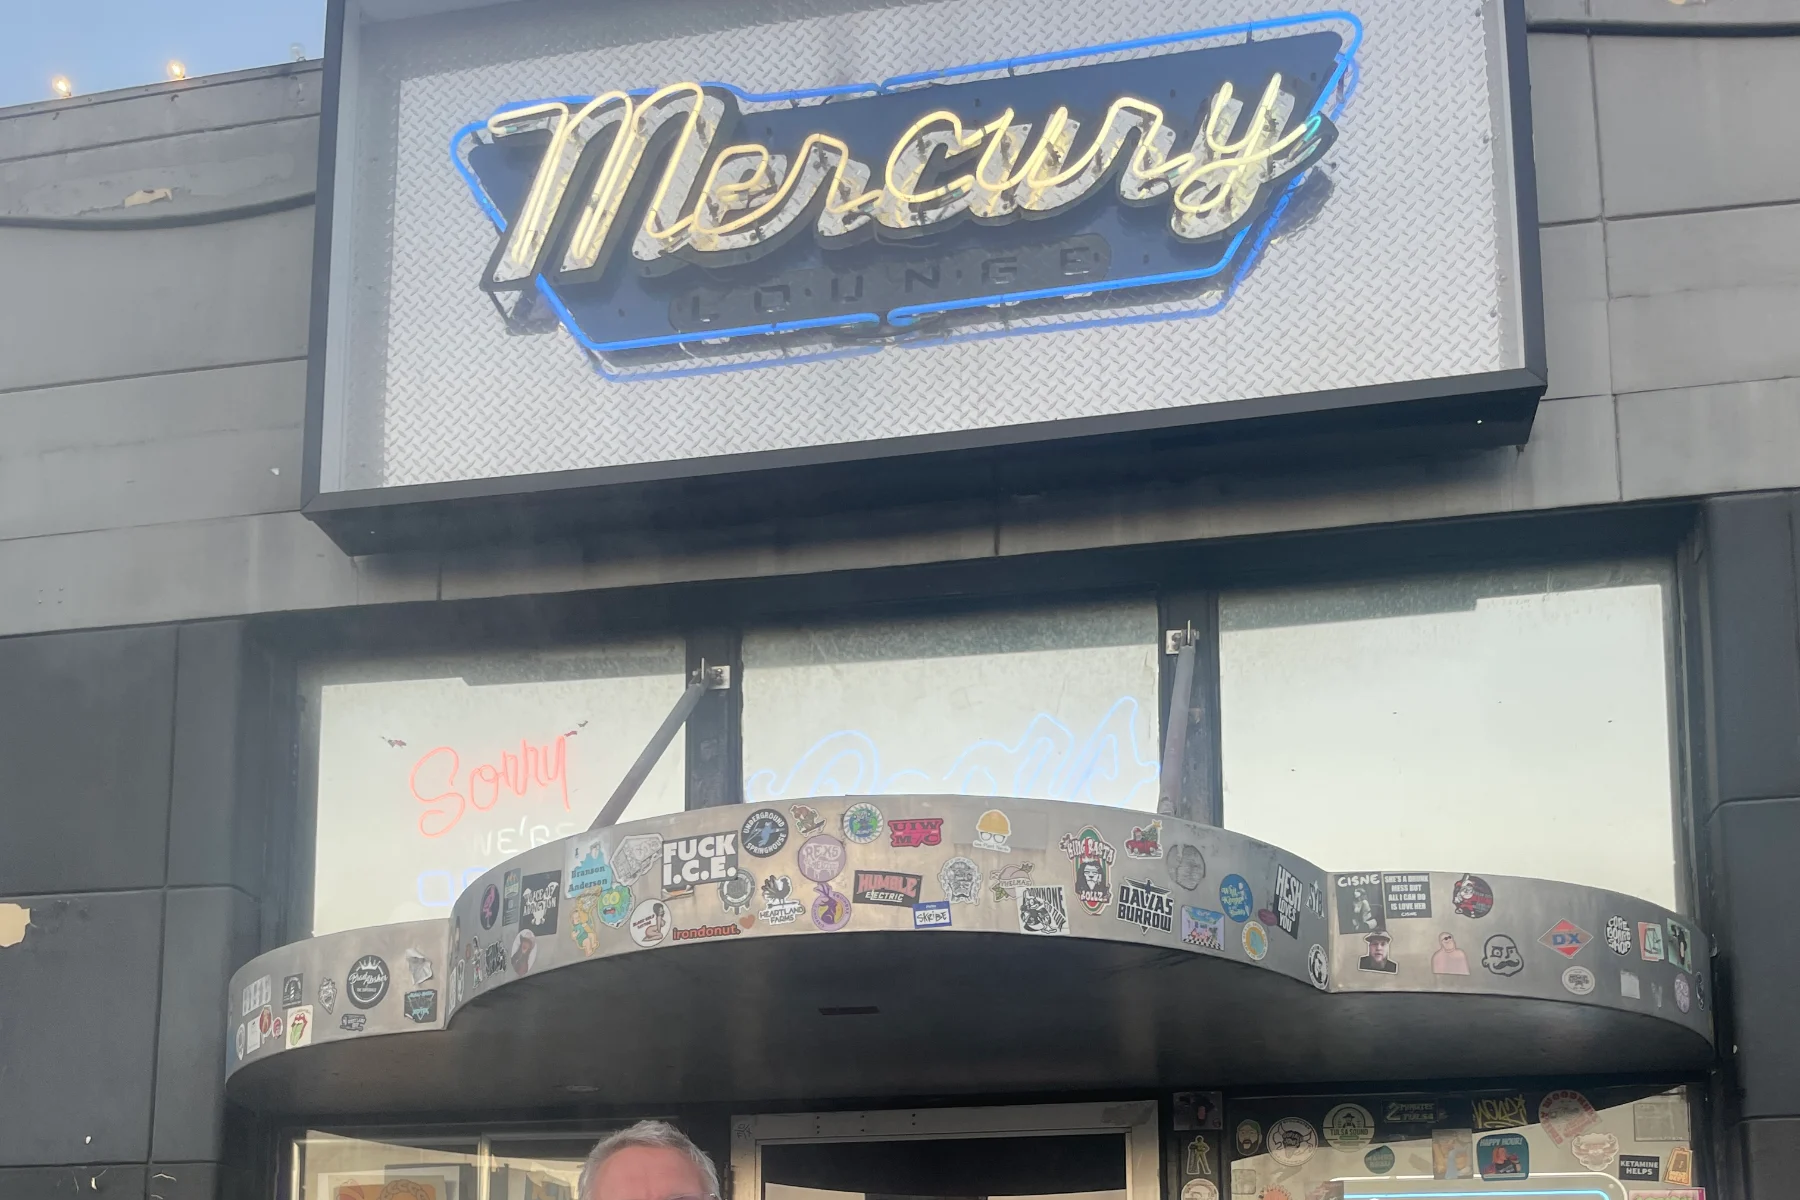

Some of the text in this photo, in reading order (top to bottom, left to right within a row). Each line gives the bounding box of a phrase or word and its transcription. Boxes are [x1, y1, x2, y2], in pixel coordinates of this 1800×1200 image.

[484, 74, 1335, 287] Mercury
[689, 244, 1100, 322] LOUNGE
[409, 735, 571, 838] Sorry
[743, 811, 785, 834] UNDERGROUND
[894, 820, 939, 831] UIW
[663, 834, 736, 864] FUCK
[745, 832, 787, 854] SPRINGHOUSE
[571, 864, 606, 879] Branson
[663, 856, 737, 886] I.C.E.
[1384, 875, 1402, 883] SHE'S
[1402, 875, 1408, 883] A
[567, 877, 608, 893] Anderson
[857, 872, 918, 898] HUMBLE
[1276, 864, 1303, 912] HESH
[1337, 873, 1381, 888] CISNE
[865, 890, 905, 903] ELECTRIC
[759, 906, 805, 919] HEARTLAND
[1277, 900, 1297, 922] LOVES
[1398, 902, 1414, 910] LOVE
[1414, 902, 1426, 910] HER
[770, 914, 795, 924] FARMS
[1117, 903, 1173, 933] BURROW
[1279, 917, 1293, 933] YOU
[672, 923, 742, 941] irondonut.
[1551, 933, 1582, 946] DX
[1330, 1128, 1369, 1136] TULSA SOUND
[1479, 1137, 1523, 1147] HAPPY HOUR!
[1620, 1160, 1659, 1169] KETAMINE
[1625, 1167, 1653, 1175] HELPS
